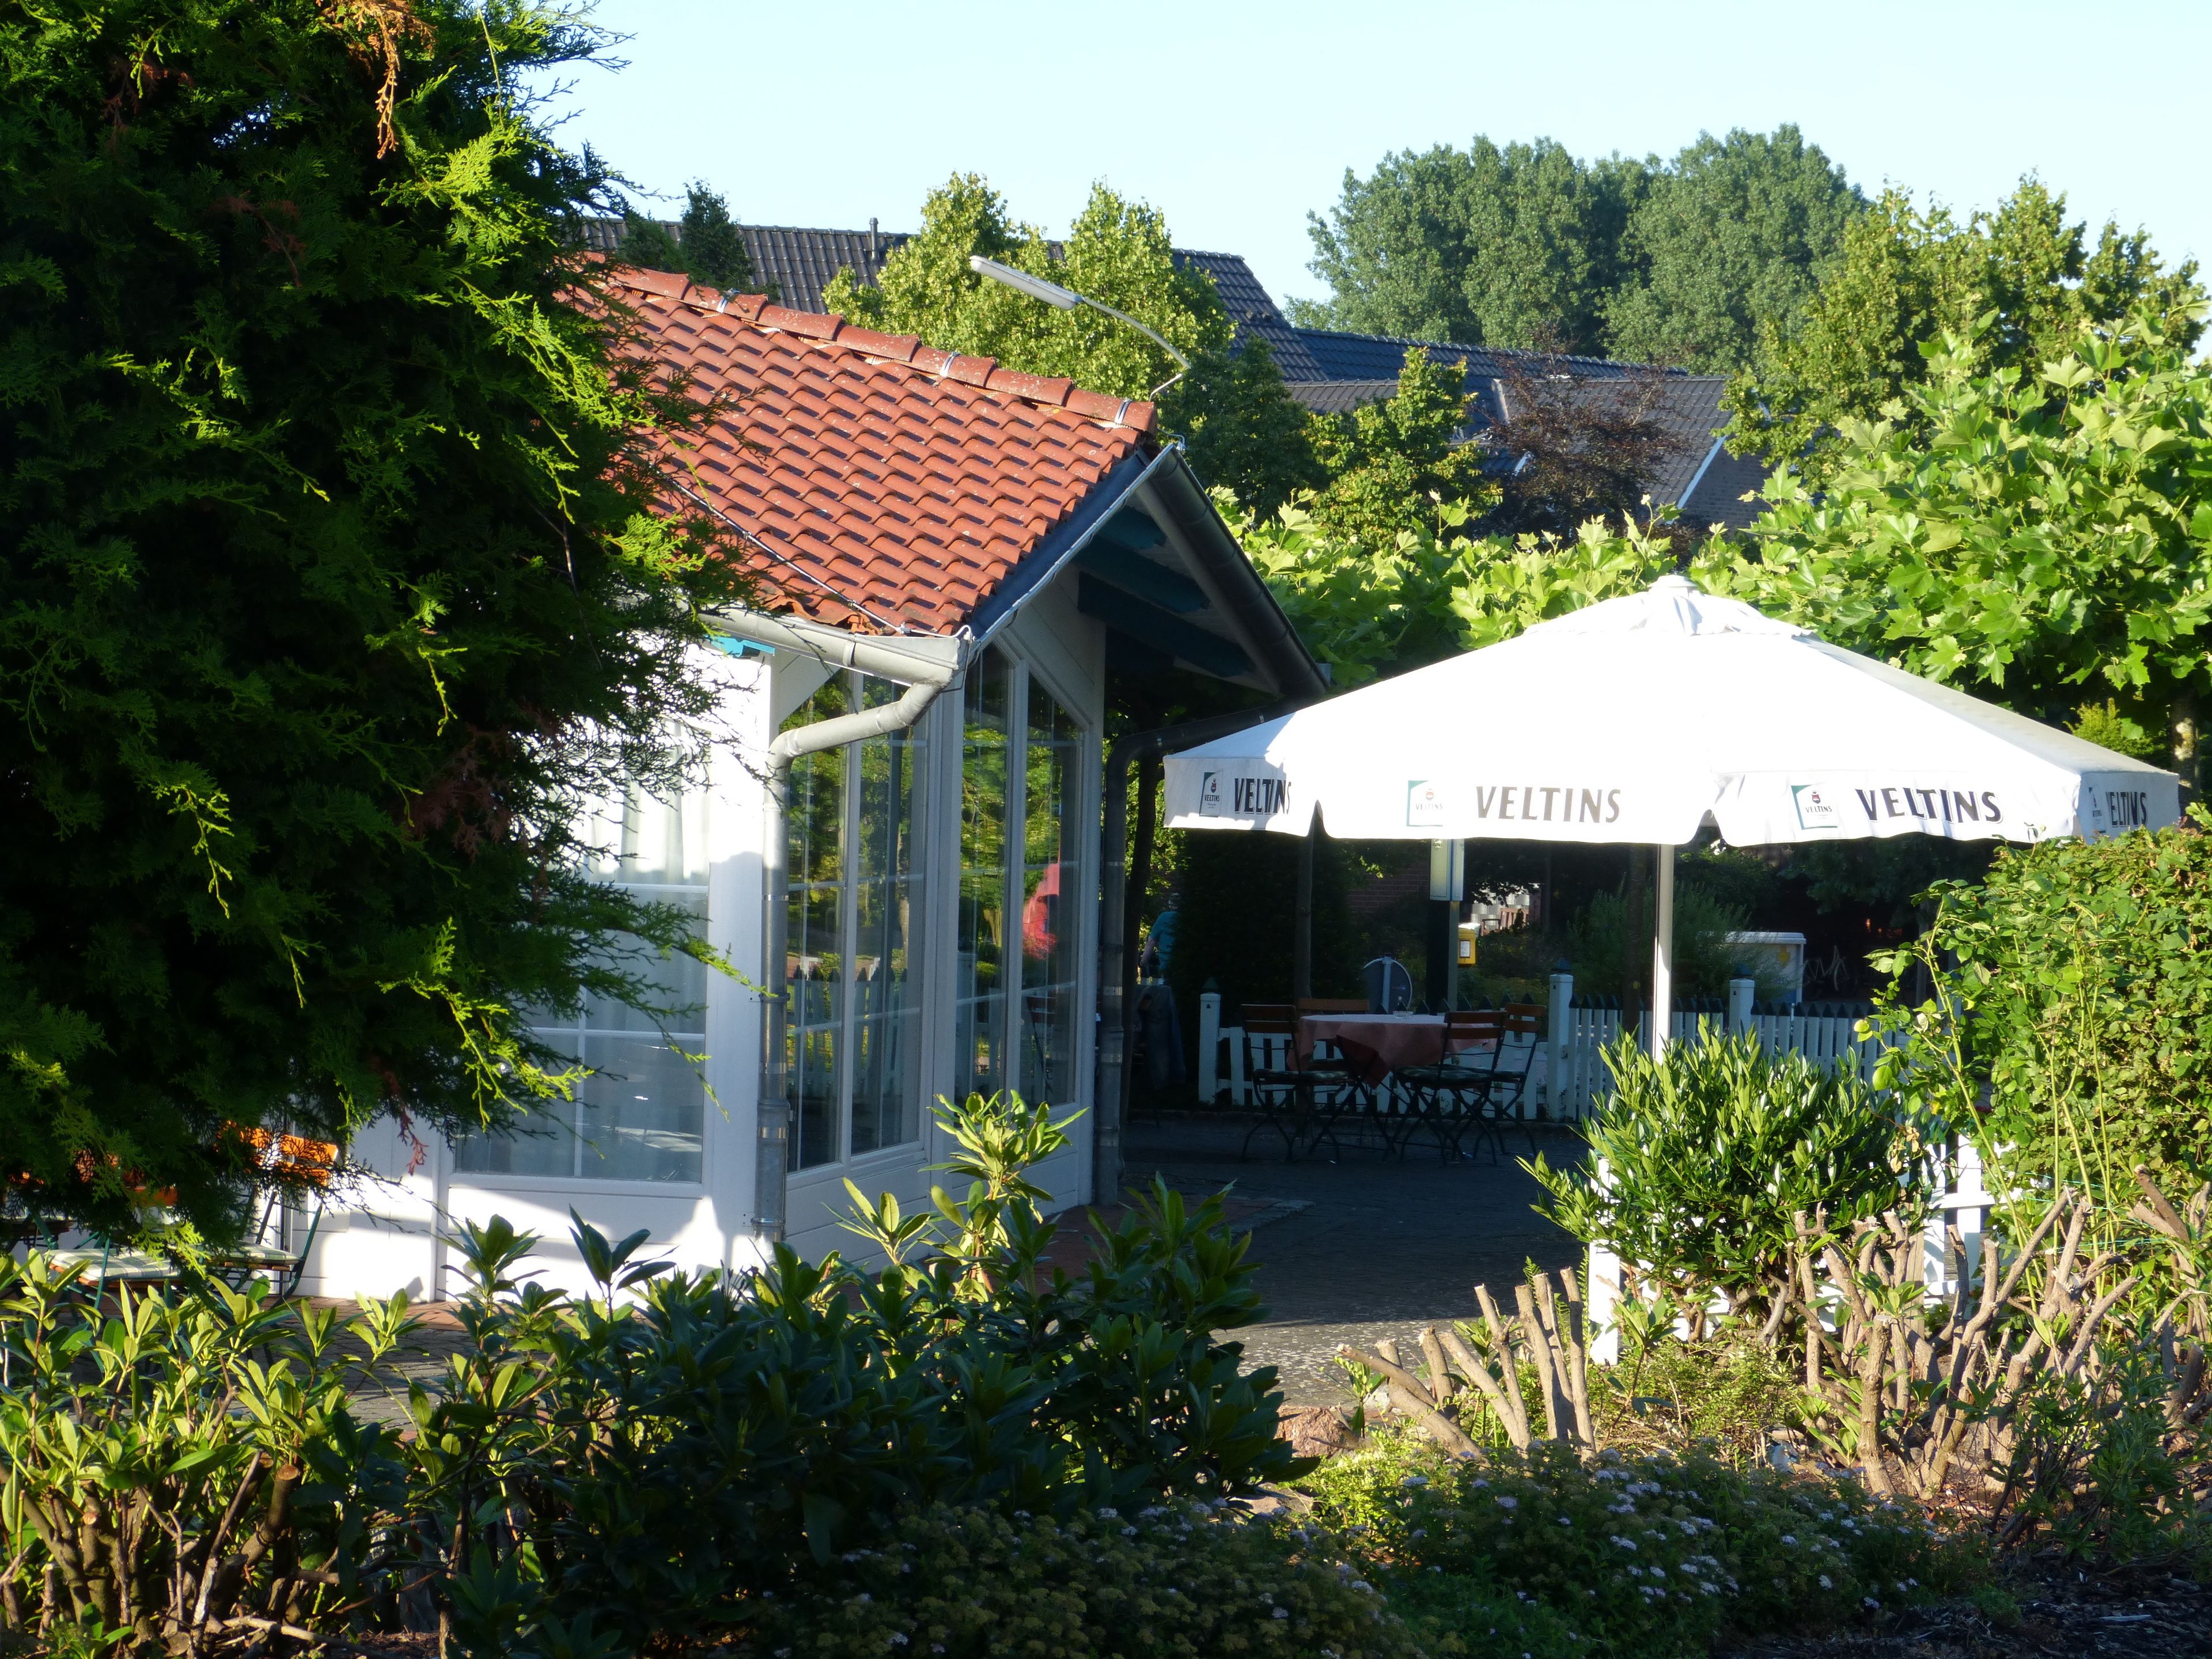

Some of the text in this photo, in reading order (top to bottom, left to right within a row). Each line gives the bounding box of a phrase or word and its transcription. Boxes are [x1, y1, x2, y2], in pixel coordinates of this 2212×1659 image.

[1234, 778, 1291, 815] VELTINS
[1476, 786, 1621, 823] VELTINS
[1855, 787, 2003, 824] VELTINS
[2105, 791, 2147, 827] VELTINS
